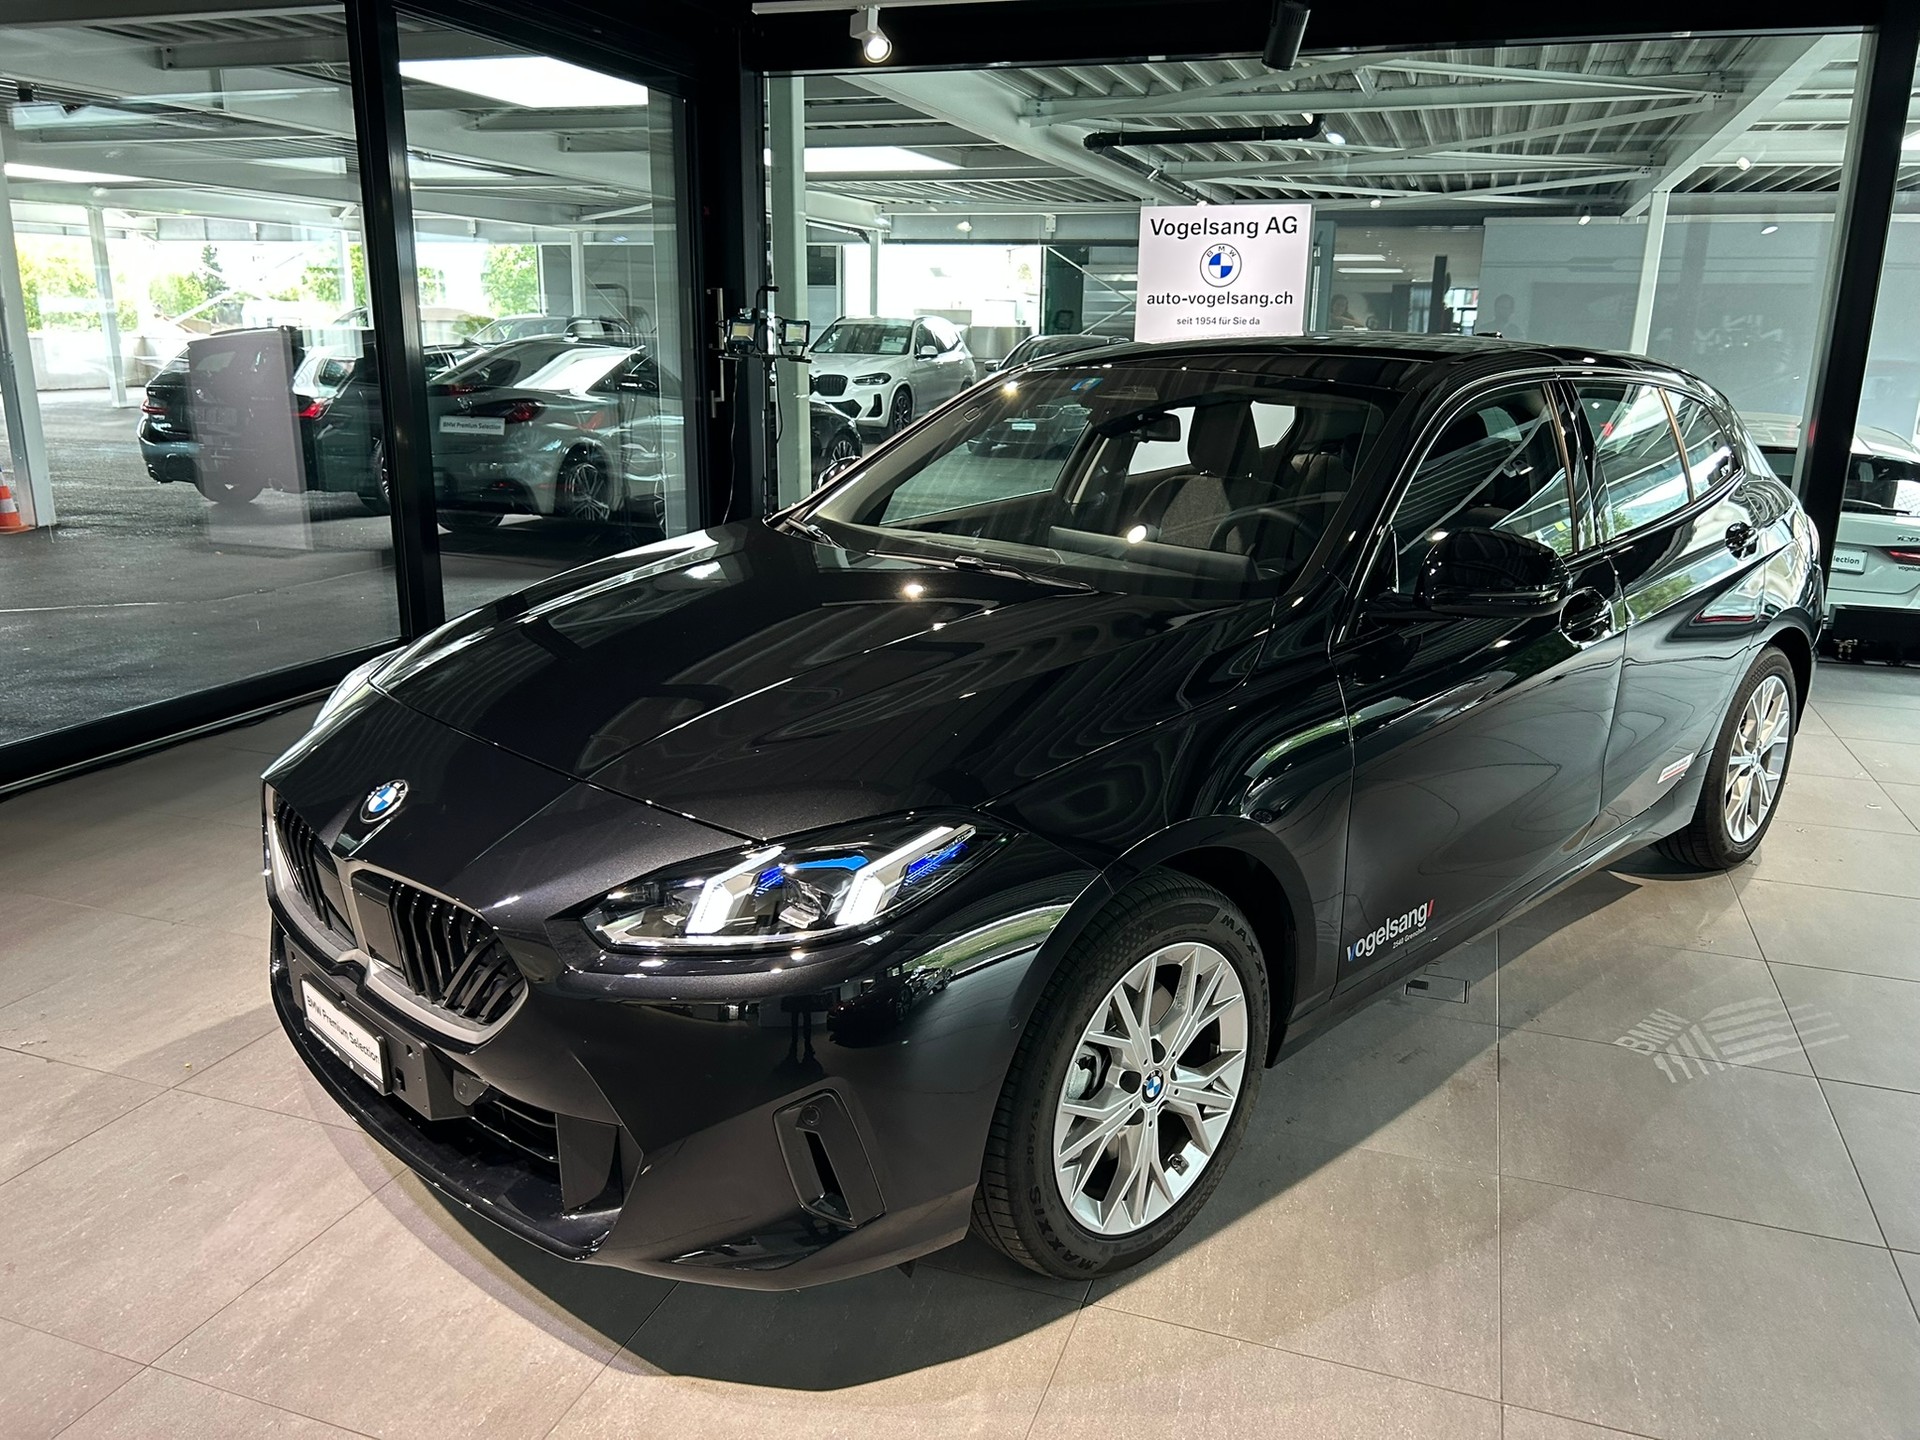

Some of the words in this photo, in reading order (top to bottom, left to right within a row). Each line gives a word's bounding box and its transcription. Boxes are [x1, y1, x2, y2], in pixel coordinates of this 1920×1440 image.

[1150, 218, 1259, 240] Vogelsang
[1265, 215, 1298, 234] AG
[1206, 246, 1237, 258] BMW
[1146, 291, 1293, 307] auto-vogelsang.ch
[1177, 317, 1193, 325] seit
[1195, 317, 1217, 325] 1954
[1218, 316, 1231, 325] für
[1232, 316, 1247, 325] Sie
[1249, 316, 1261, 325] da
[1346, 902, 1428, 962] vogelsang
[1613, 1008, 1690, 1056] BMW
[1029, 1185, 1098, 1270] MAXXIS
